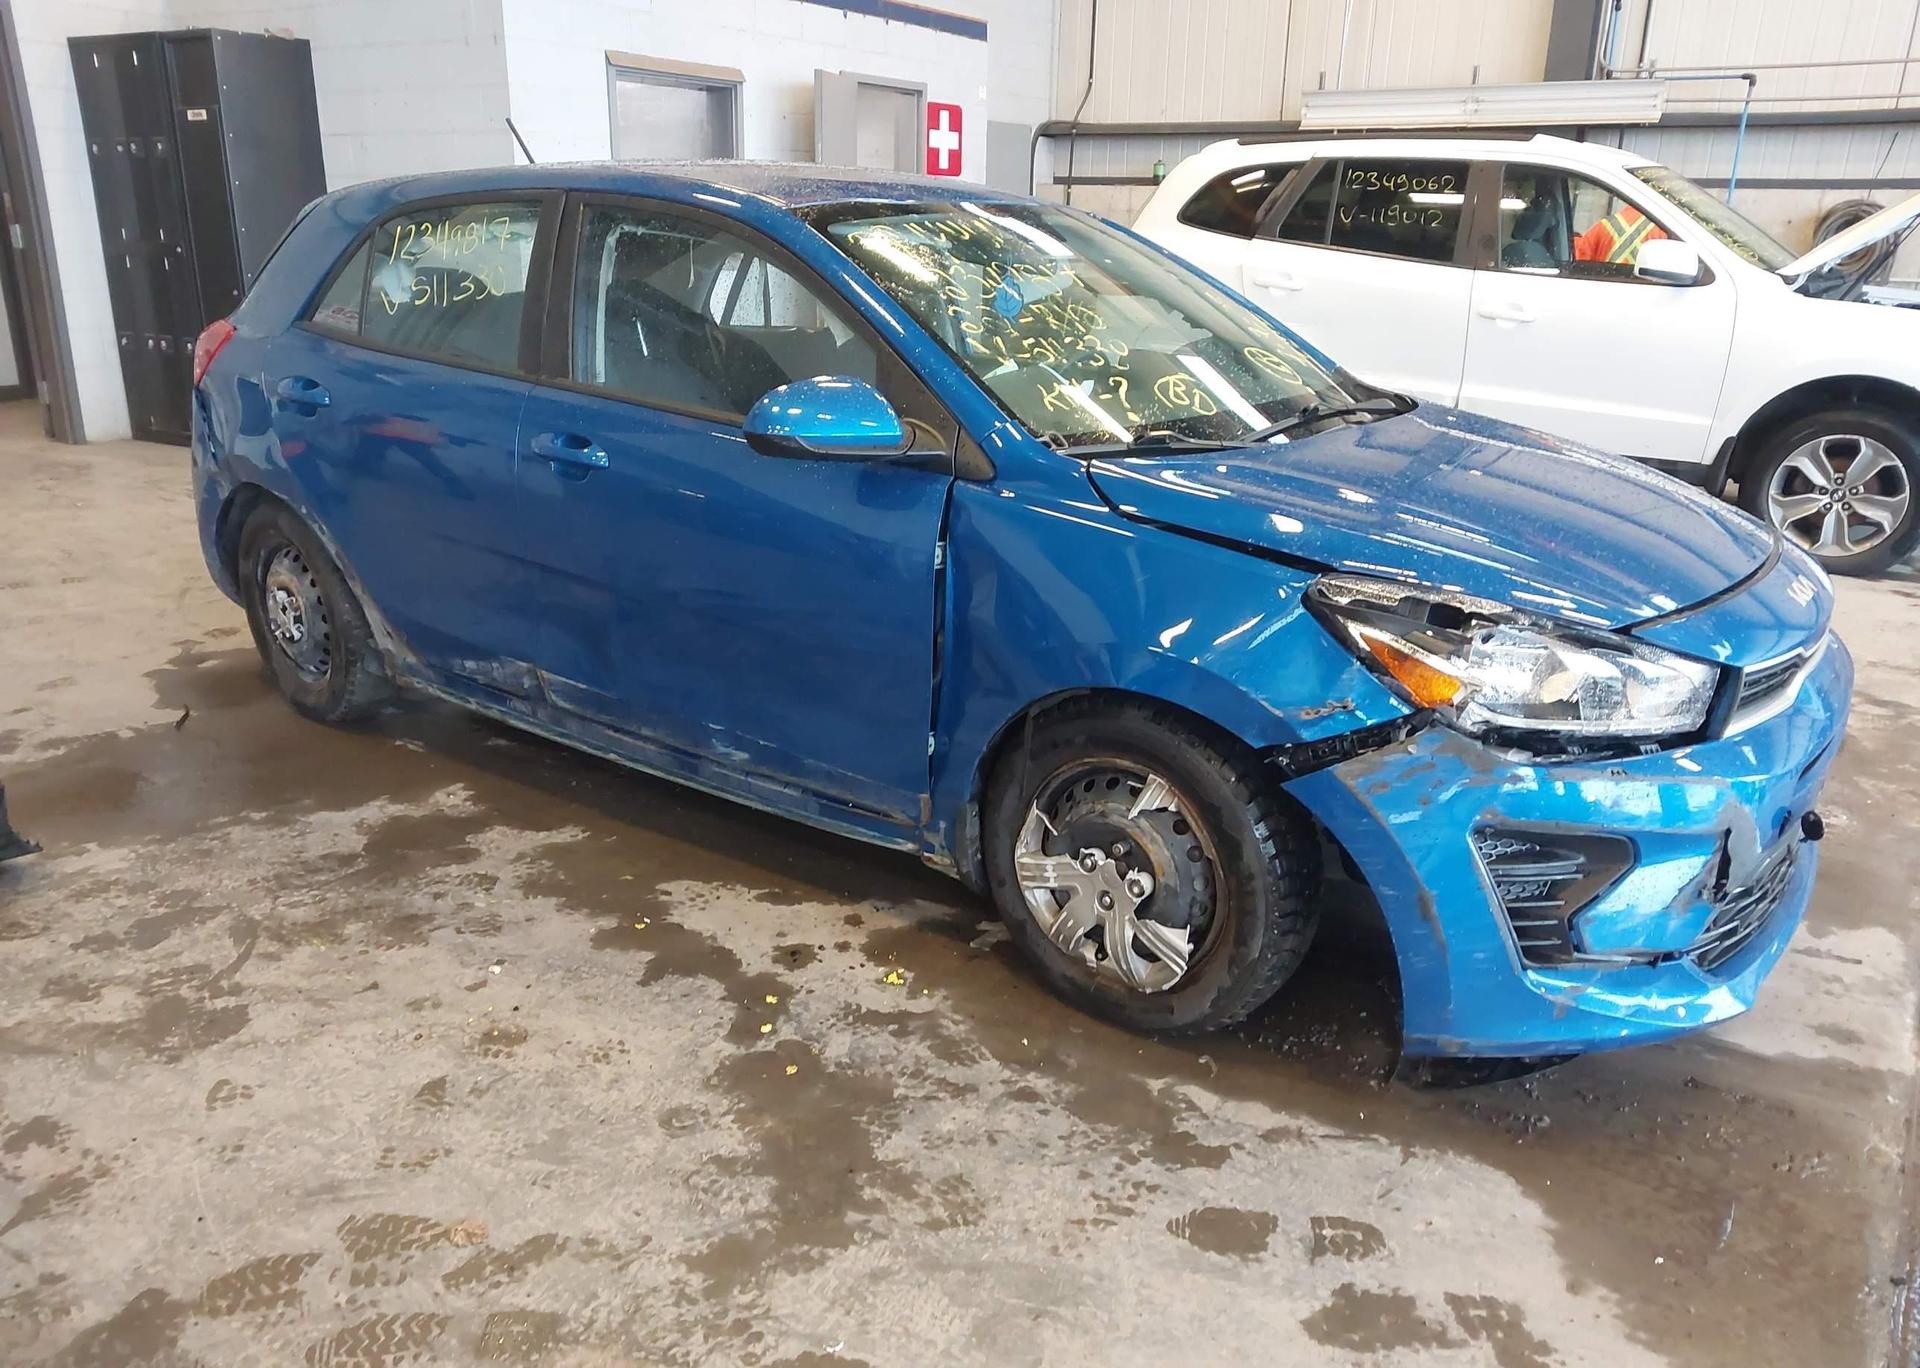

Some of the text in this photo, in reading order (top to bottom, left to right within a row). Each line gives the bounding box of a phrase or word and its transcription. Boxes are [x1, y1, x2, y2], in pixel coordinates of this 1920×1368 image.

[1344, 168, 1457, 193] 12349062
[1340, 204, 1443, 227] V-119012
[389, 216, 510, 264] 12349817
